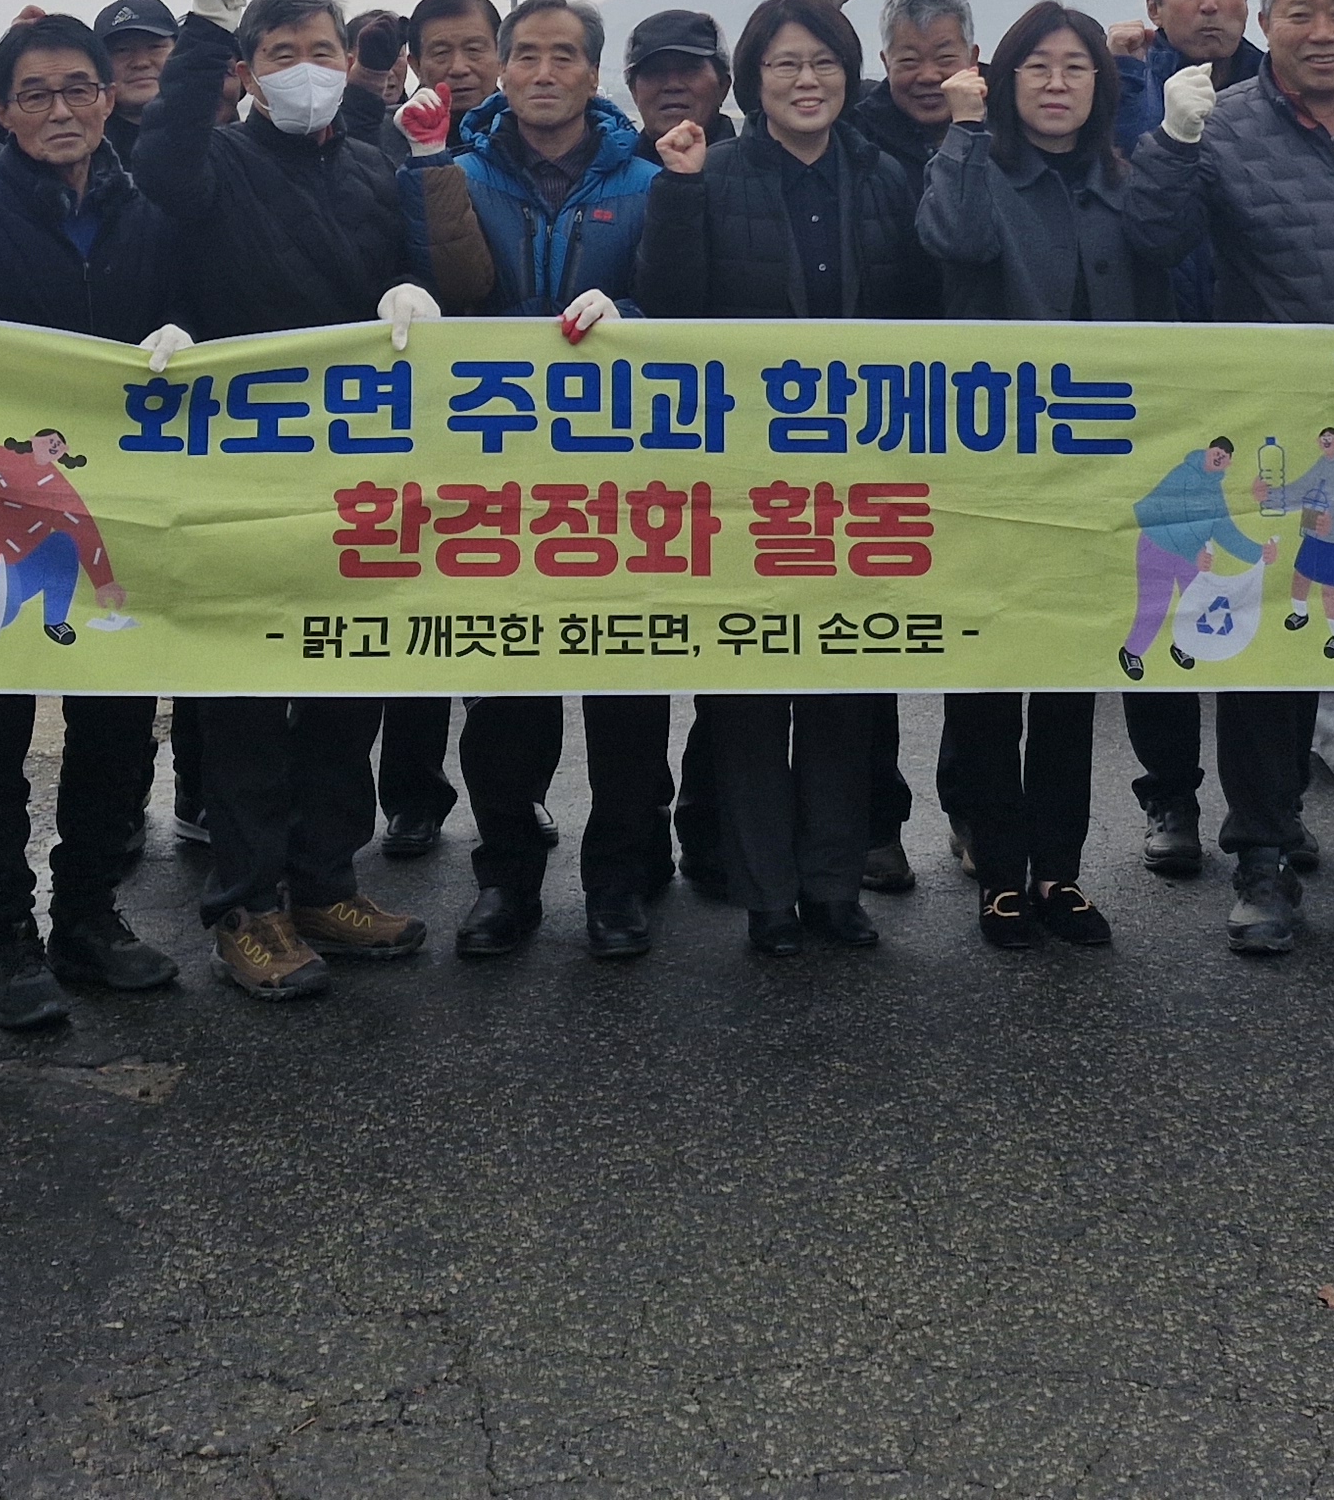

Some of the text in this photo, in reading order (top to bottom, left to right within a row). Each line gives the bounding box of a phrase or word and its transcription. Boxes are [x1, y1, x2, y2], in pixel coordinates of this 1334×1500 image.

[119, 358, 1137, 456] 화도면 주민과 함께하는
[333, 480, 934, 579] 환경정화 활동
[302, 616, 391, 659] 맑고
[406, 613, 544, 658] 깨끗한
[558, 613, 701, 657] 화도면,
[717, 612, 801, 656] 우리
[818, 612, 945, 655] 손으로
